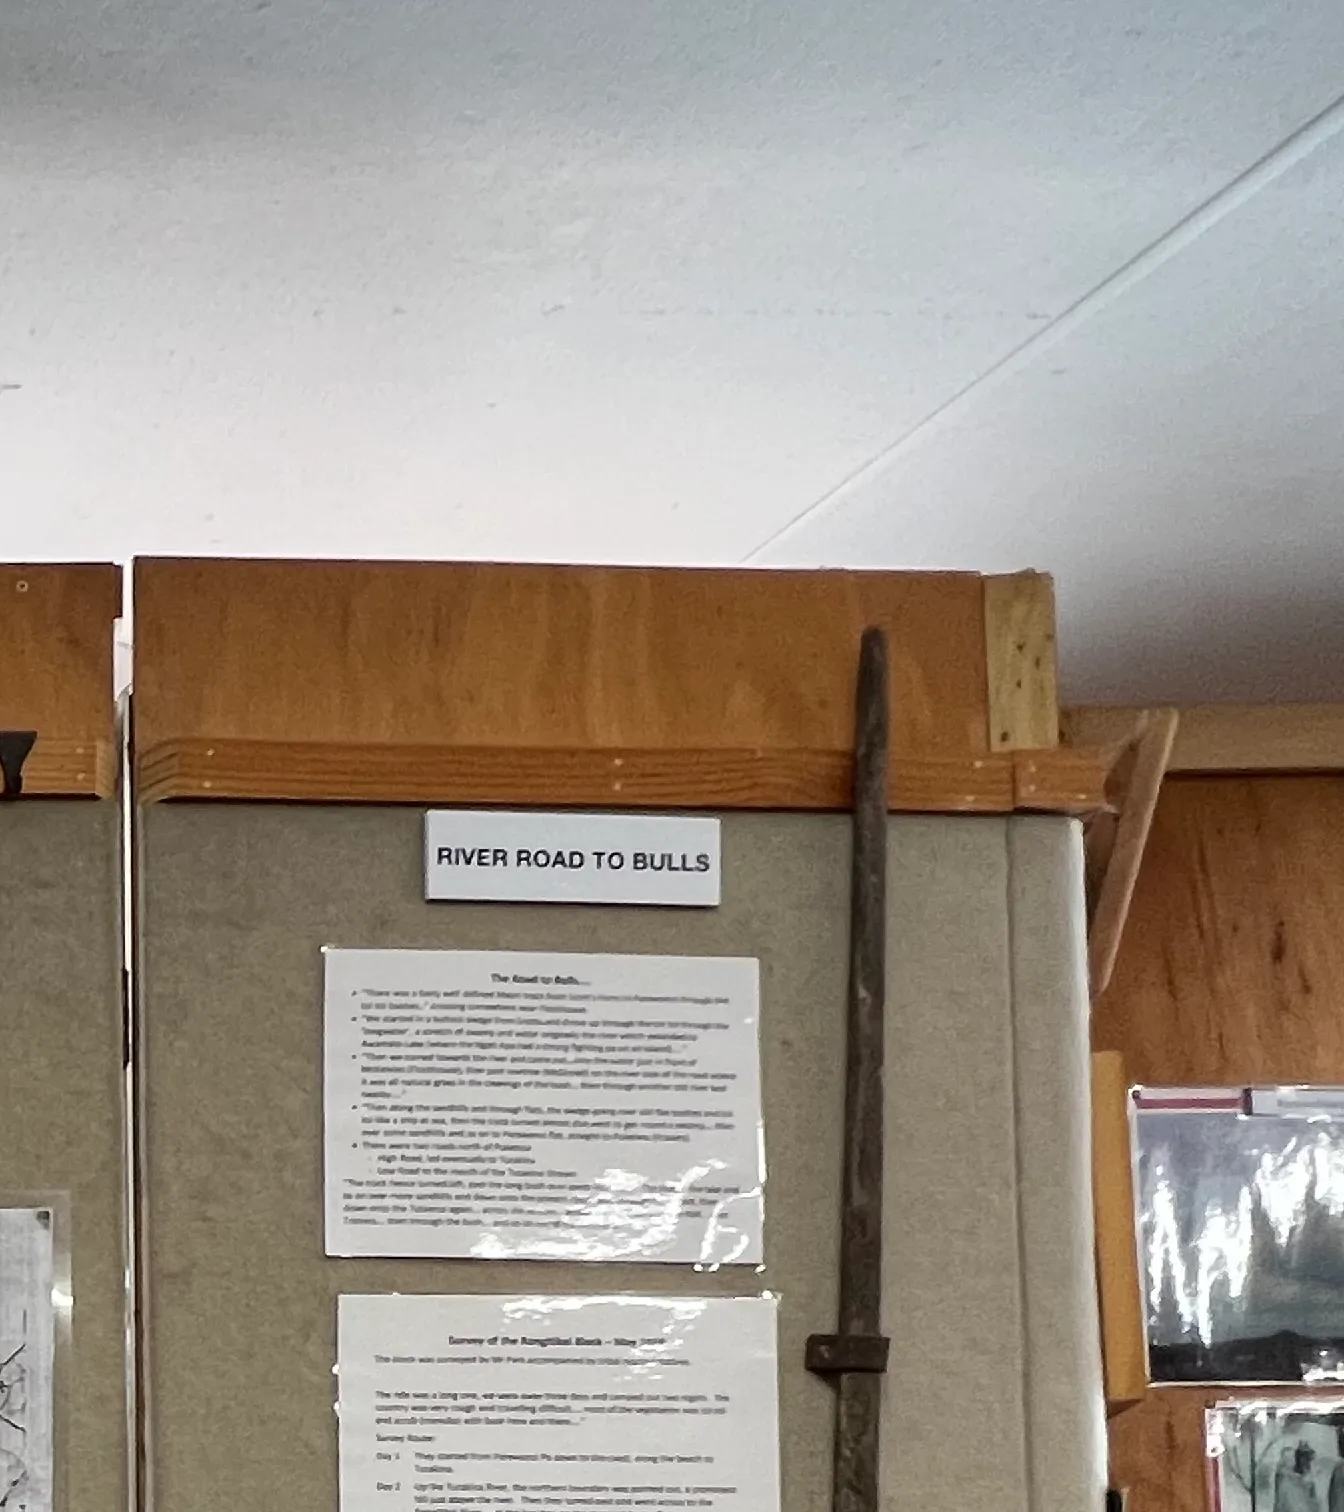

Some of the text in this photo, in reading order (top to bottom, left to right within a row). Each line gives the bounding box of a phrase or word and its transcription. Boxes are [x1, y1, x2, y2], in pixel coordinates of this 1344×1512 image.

[437, 846, 710, 872] RIVER ROAD TO BULLS
